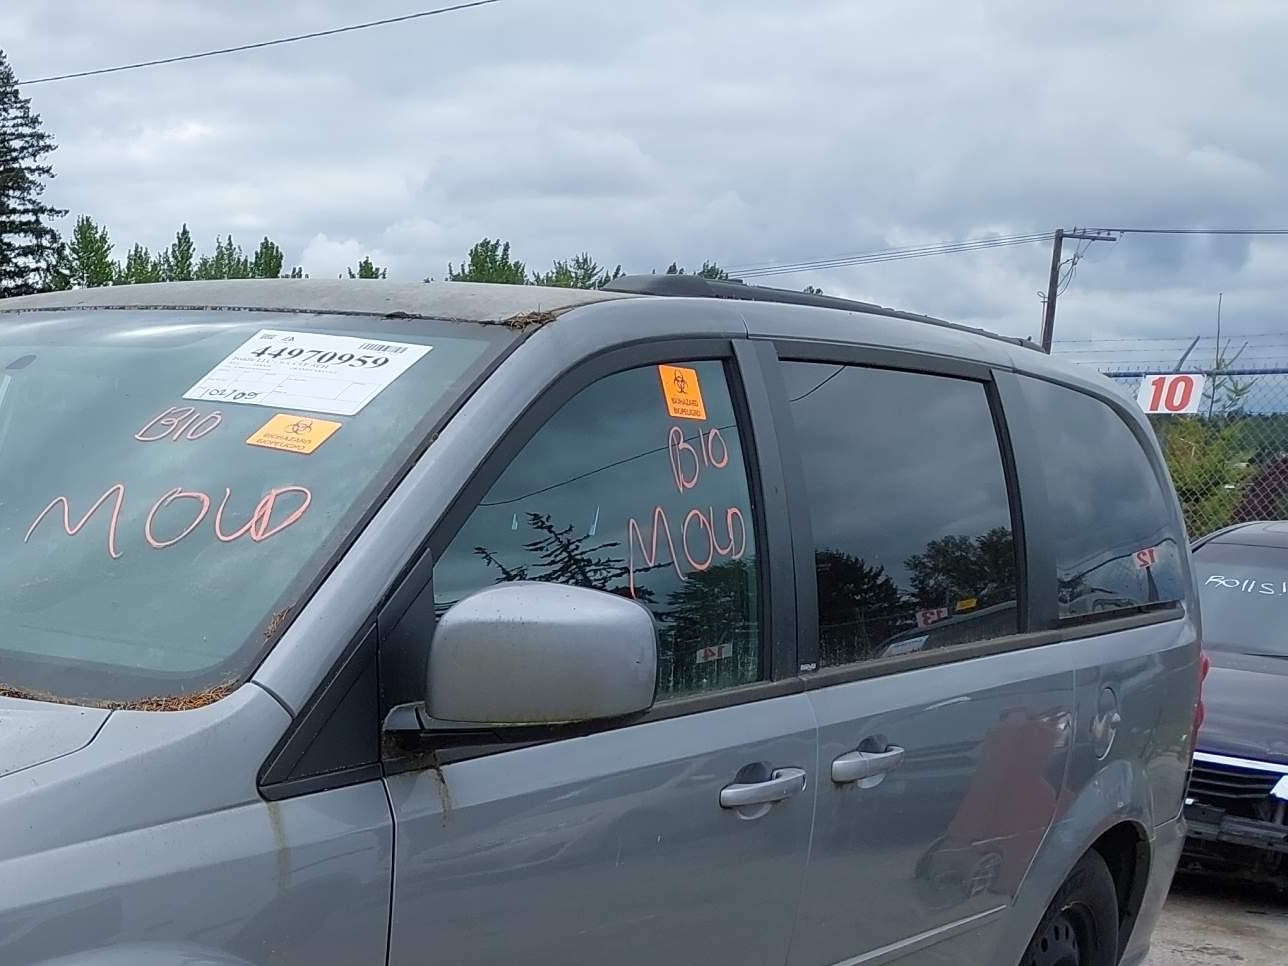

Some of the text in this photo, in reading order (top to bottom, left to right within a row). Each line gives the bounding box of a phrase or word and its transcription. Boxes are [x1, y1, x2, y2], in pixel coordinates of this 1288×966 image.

[250, 344, 390, 369] 44970959
[1149, 375, 1195, 412] 10
[134, 405, 223, 442] BIO
[668, 426, 729, 494] BIO
[23, 482, 313, 559] MOLD
[628, 504, 746, 600] MOLD
